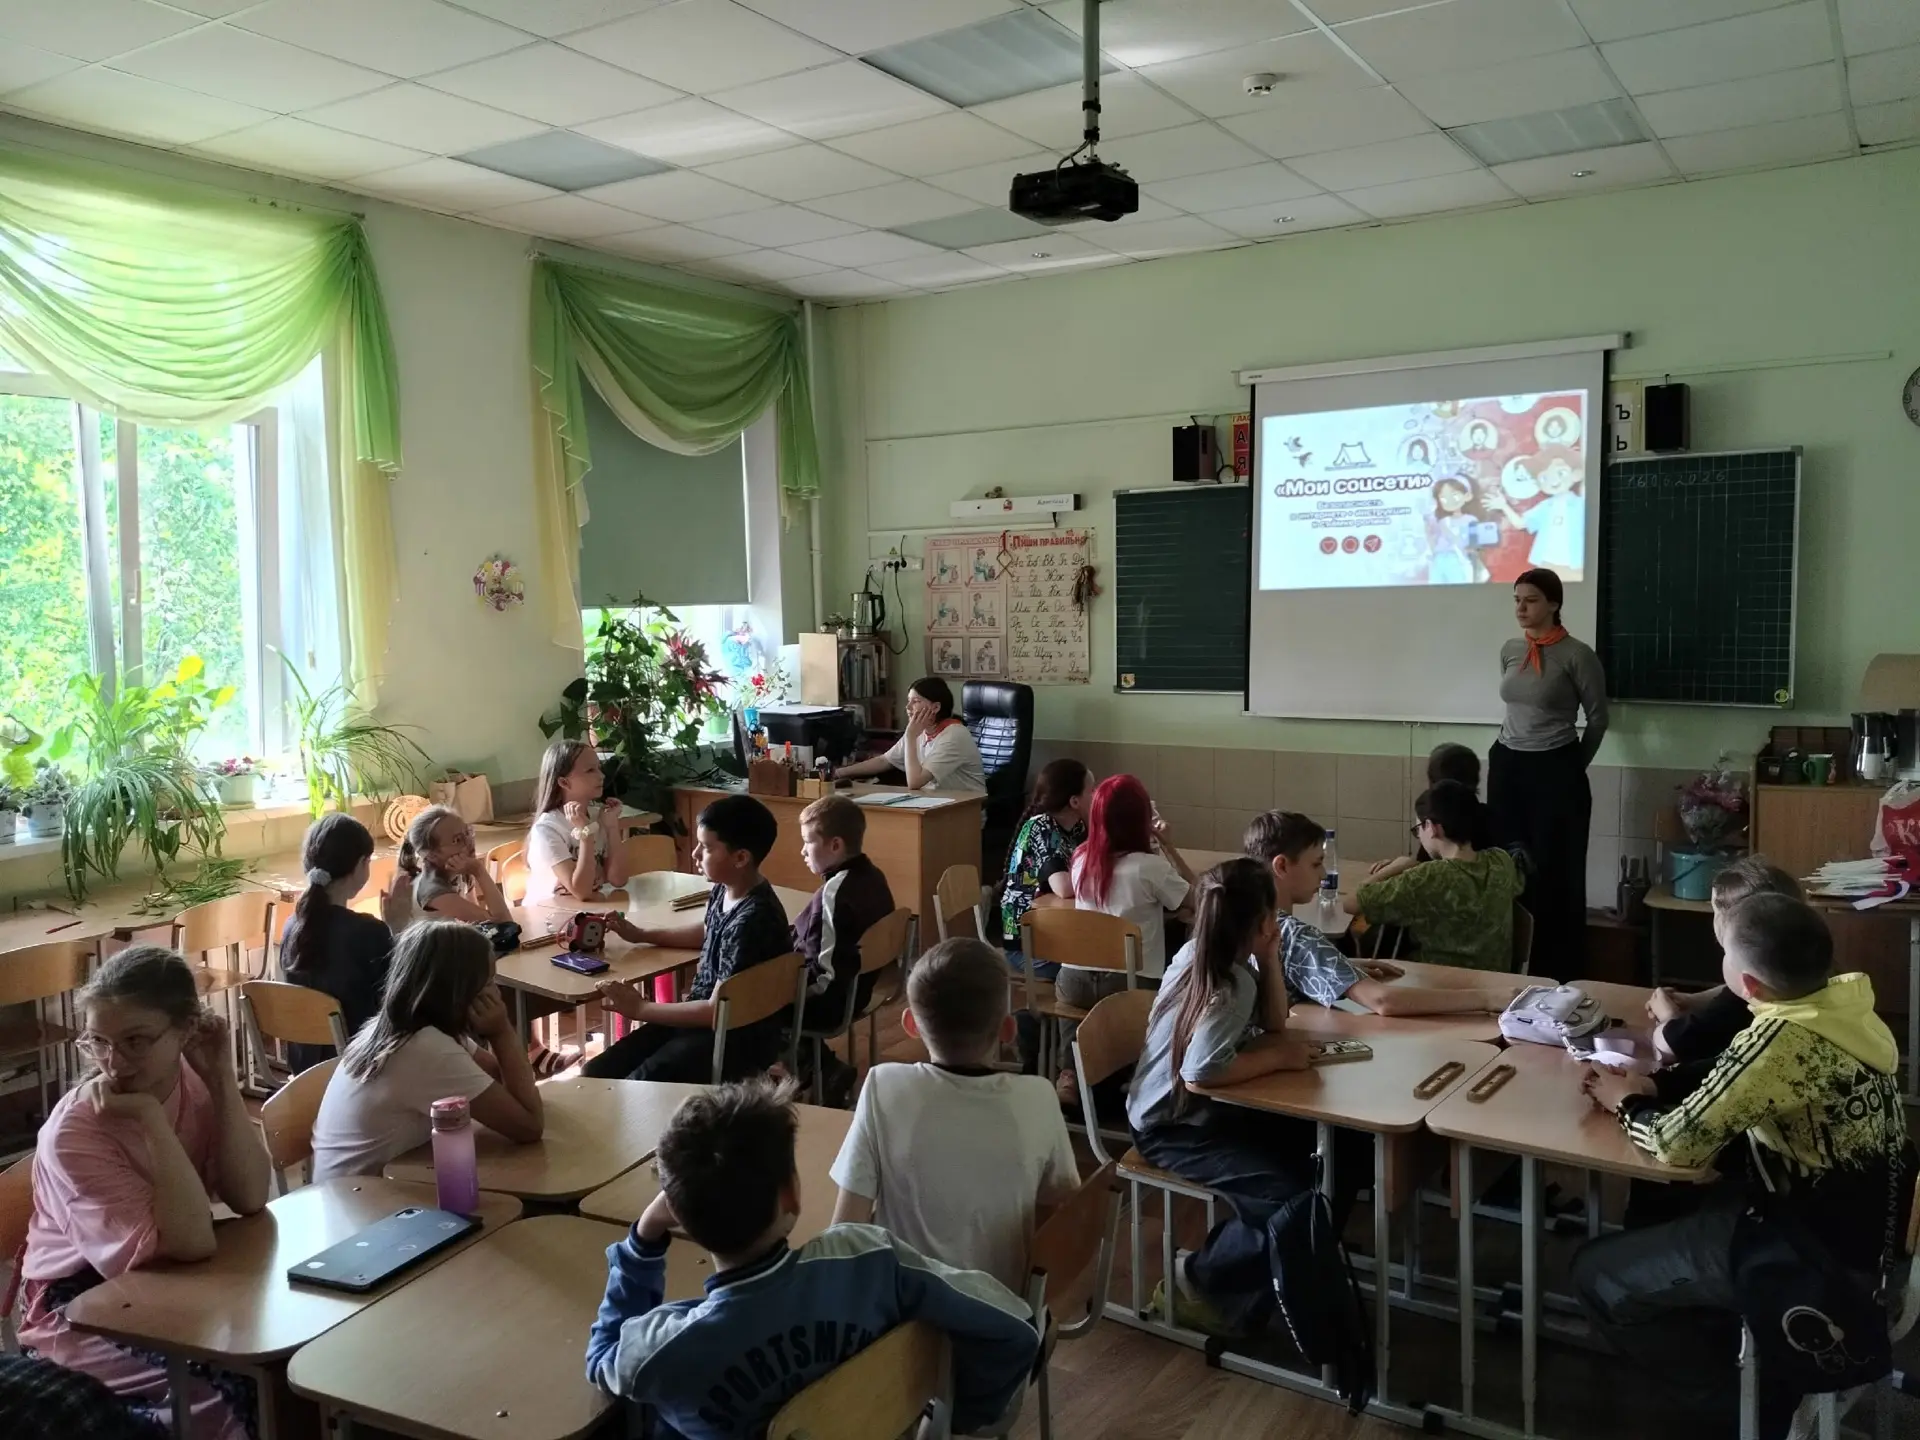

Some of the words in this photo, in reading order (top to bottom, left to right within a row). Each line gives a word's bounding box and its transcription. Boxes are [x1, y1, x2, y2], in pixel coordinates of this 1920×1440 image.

[1615, 403, 1631, 420] Ъ
[1236, 430, 1246, 444] А
[1616, 435, 1628, 451] Ь
[1236, 456, 1246, 470] Я
[1275, 478, 1330, 497] «Мои
[1334, 474, 1432, 494] соцсети»
